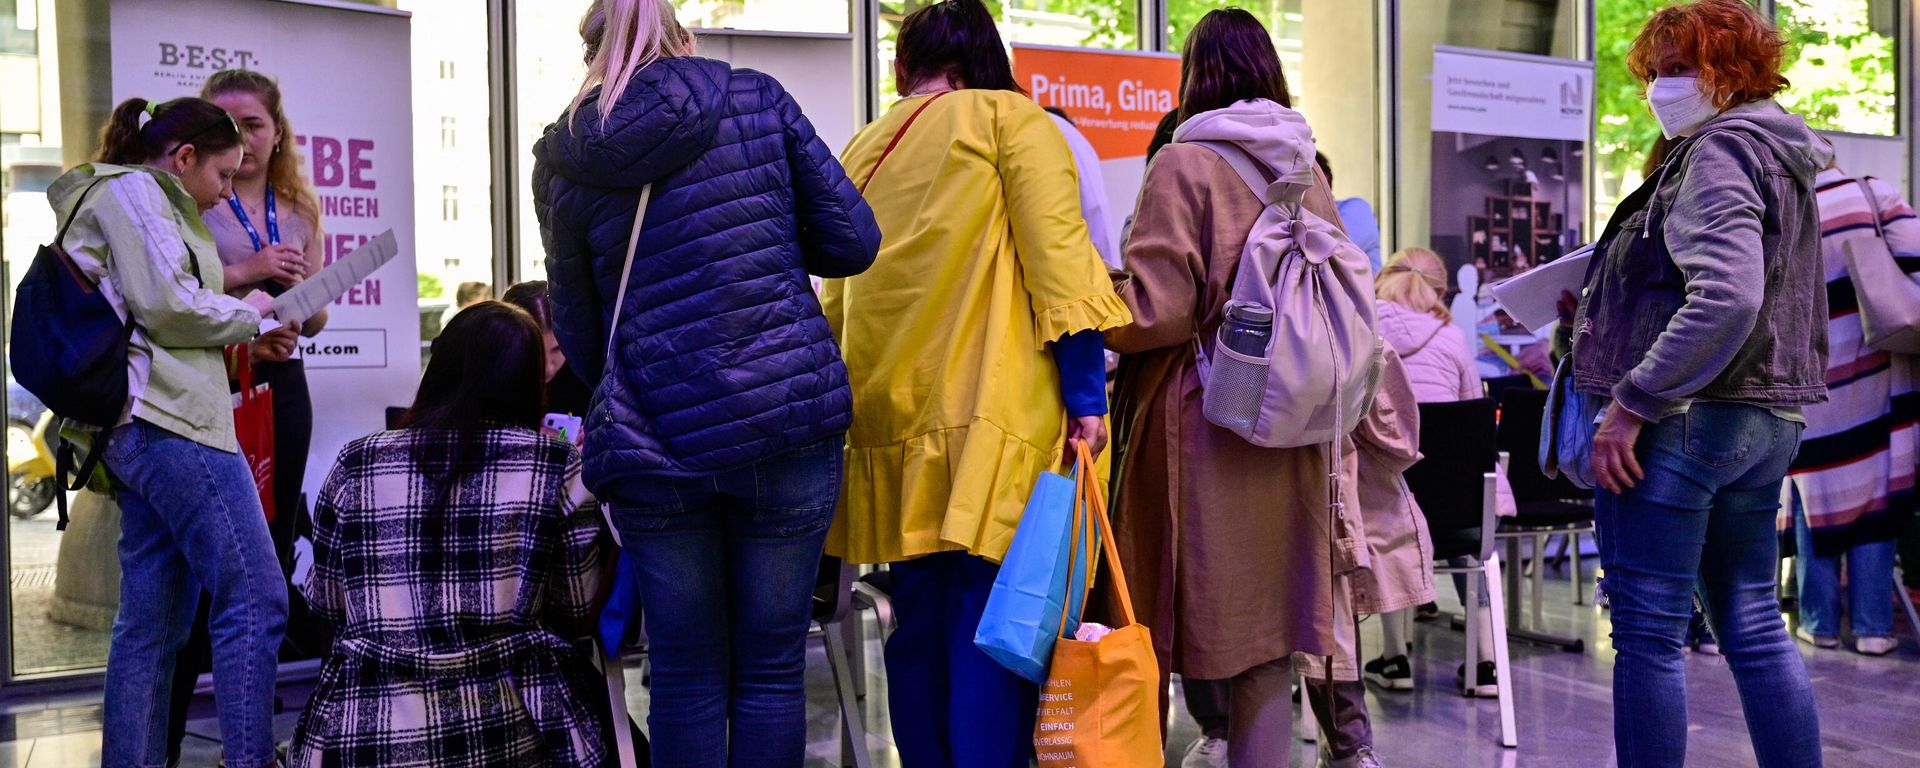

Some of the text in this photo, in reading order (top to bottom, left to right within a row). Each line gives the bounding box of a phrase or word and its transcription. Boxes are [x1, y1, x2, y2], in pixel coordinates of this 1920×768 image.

[1031, 74, 1172, 115] Prima, Gina
[1048, 679, 1072, 688] HLEN
[1040, 722, 1075, 732] EINFACH
